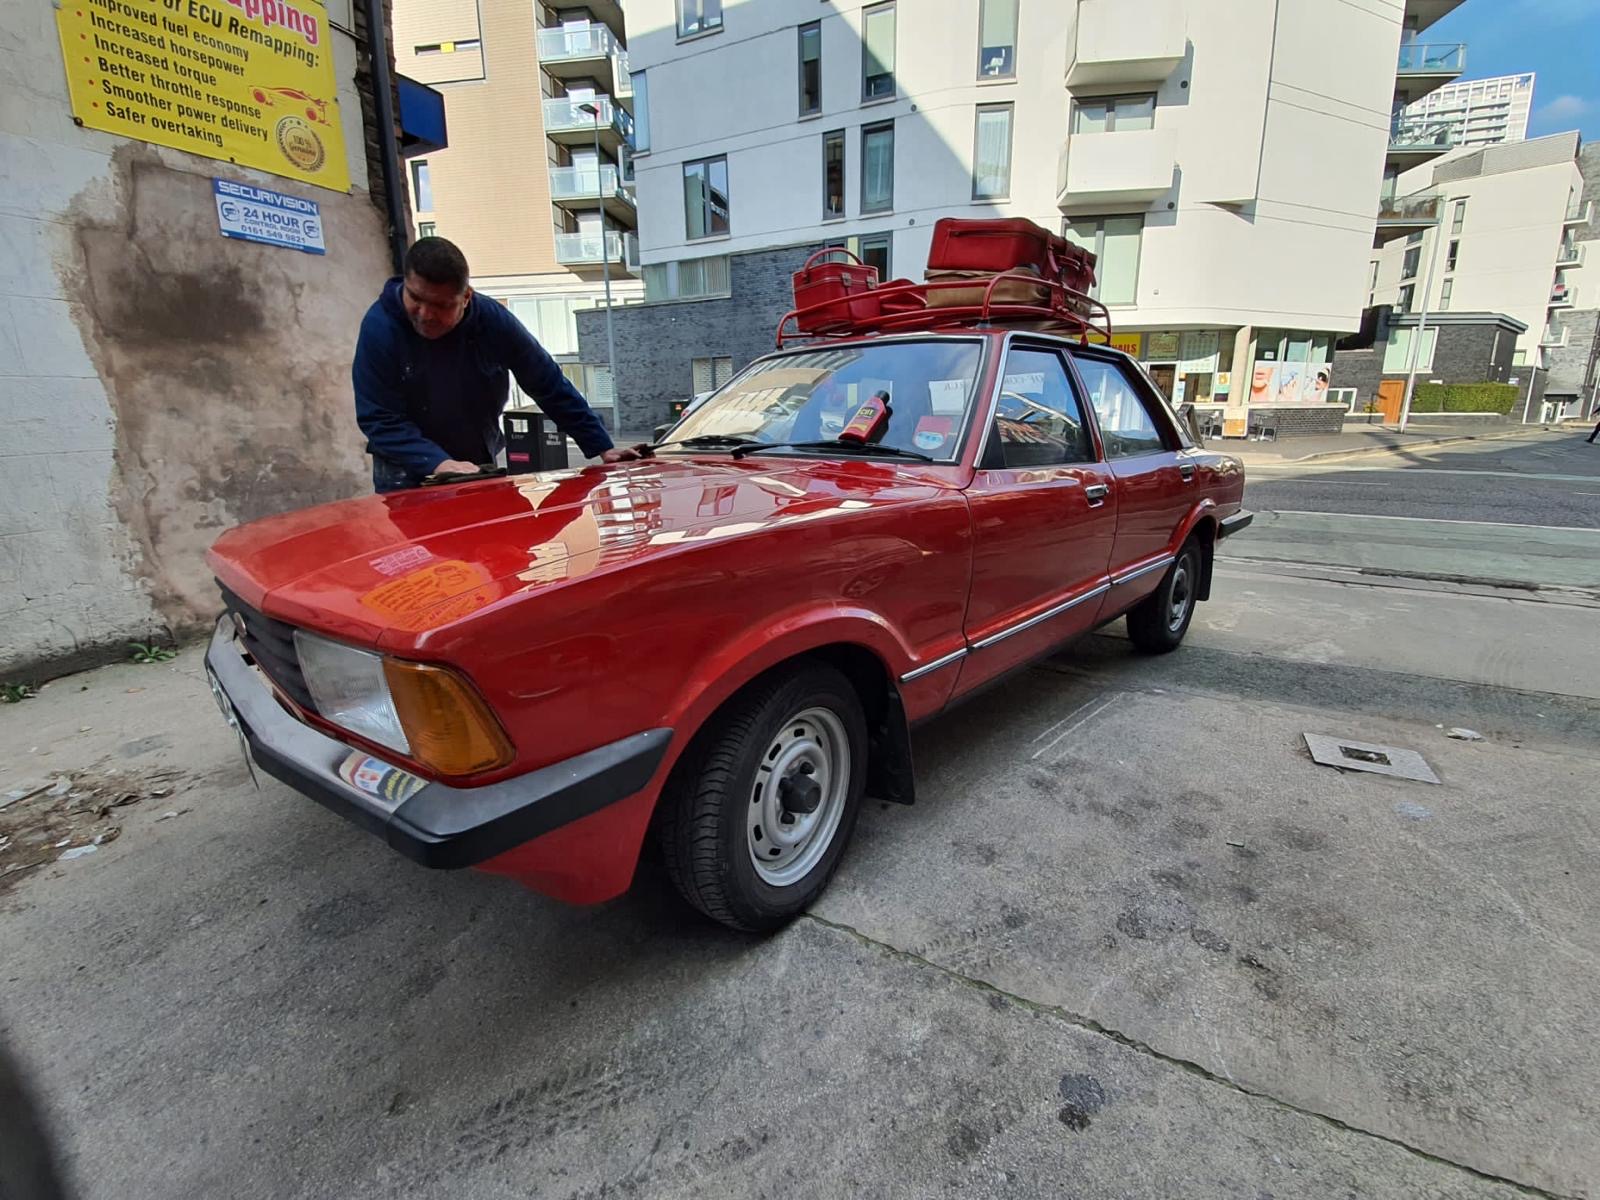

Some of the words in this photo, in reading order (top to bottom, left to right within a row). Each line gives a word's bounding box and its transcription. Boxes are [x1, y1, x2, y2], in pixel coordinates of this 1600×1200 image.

[89, 0, 157, 26] mproved
[162, 16, 188, 38] fuel
[193, 31, 249, 62] economy
[90, 11, 165, 49] Increased
[170, 39, 245, 77] horsepower
[188, 0, 222, 28] ECU
[228, 16, 319, 68] Remapping:
[227, 0, 318, 45] pping
[94, 33, 169, 71] Increased
[173, 60, 217, 86] torque
[98, 56, 145, 84] Better
[150, 73, 202, 100] throttle
[206, 92, 262, 119] response
[102, 79, 173, 111] Smoother
[176, 103, 217, 124] power
[221, 115, 268, 142] delivery
[106, 101, 146, 124] Safer
[151, 116, 224, 148] overtaking
[218, 181, 318, 213] SECURIVISION
[243, 207, 259, 220] 24
[262, 211, 300, 229] HOUR
[244, 218, 279, 231] CONTROL
